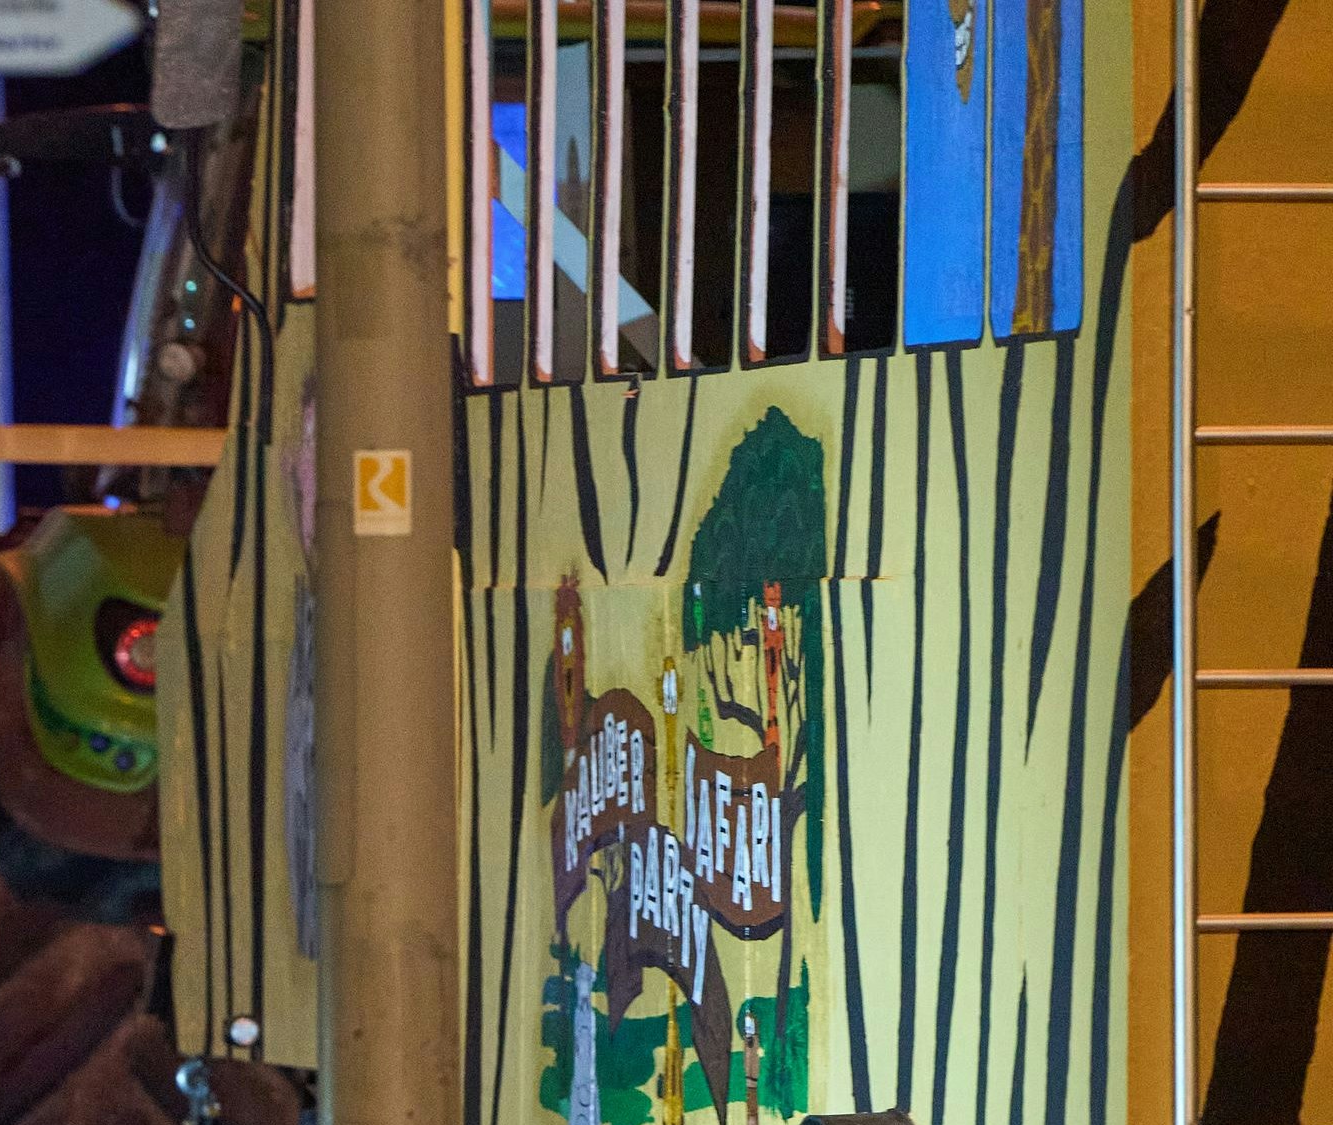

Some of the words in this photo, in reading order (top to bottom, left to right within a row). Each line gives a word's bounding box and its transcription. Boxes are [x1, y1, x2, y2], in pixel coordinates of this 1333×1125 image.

[565, 712, 645, 872] KAUBER
[685, 743, 782, 912] SAFARI
[629, 826, 710, 1006] PARTY
